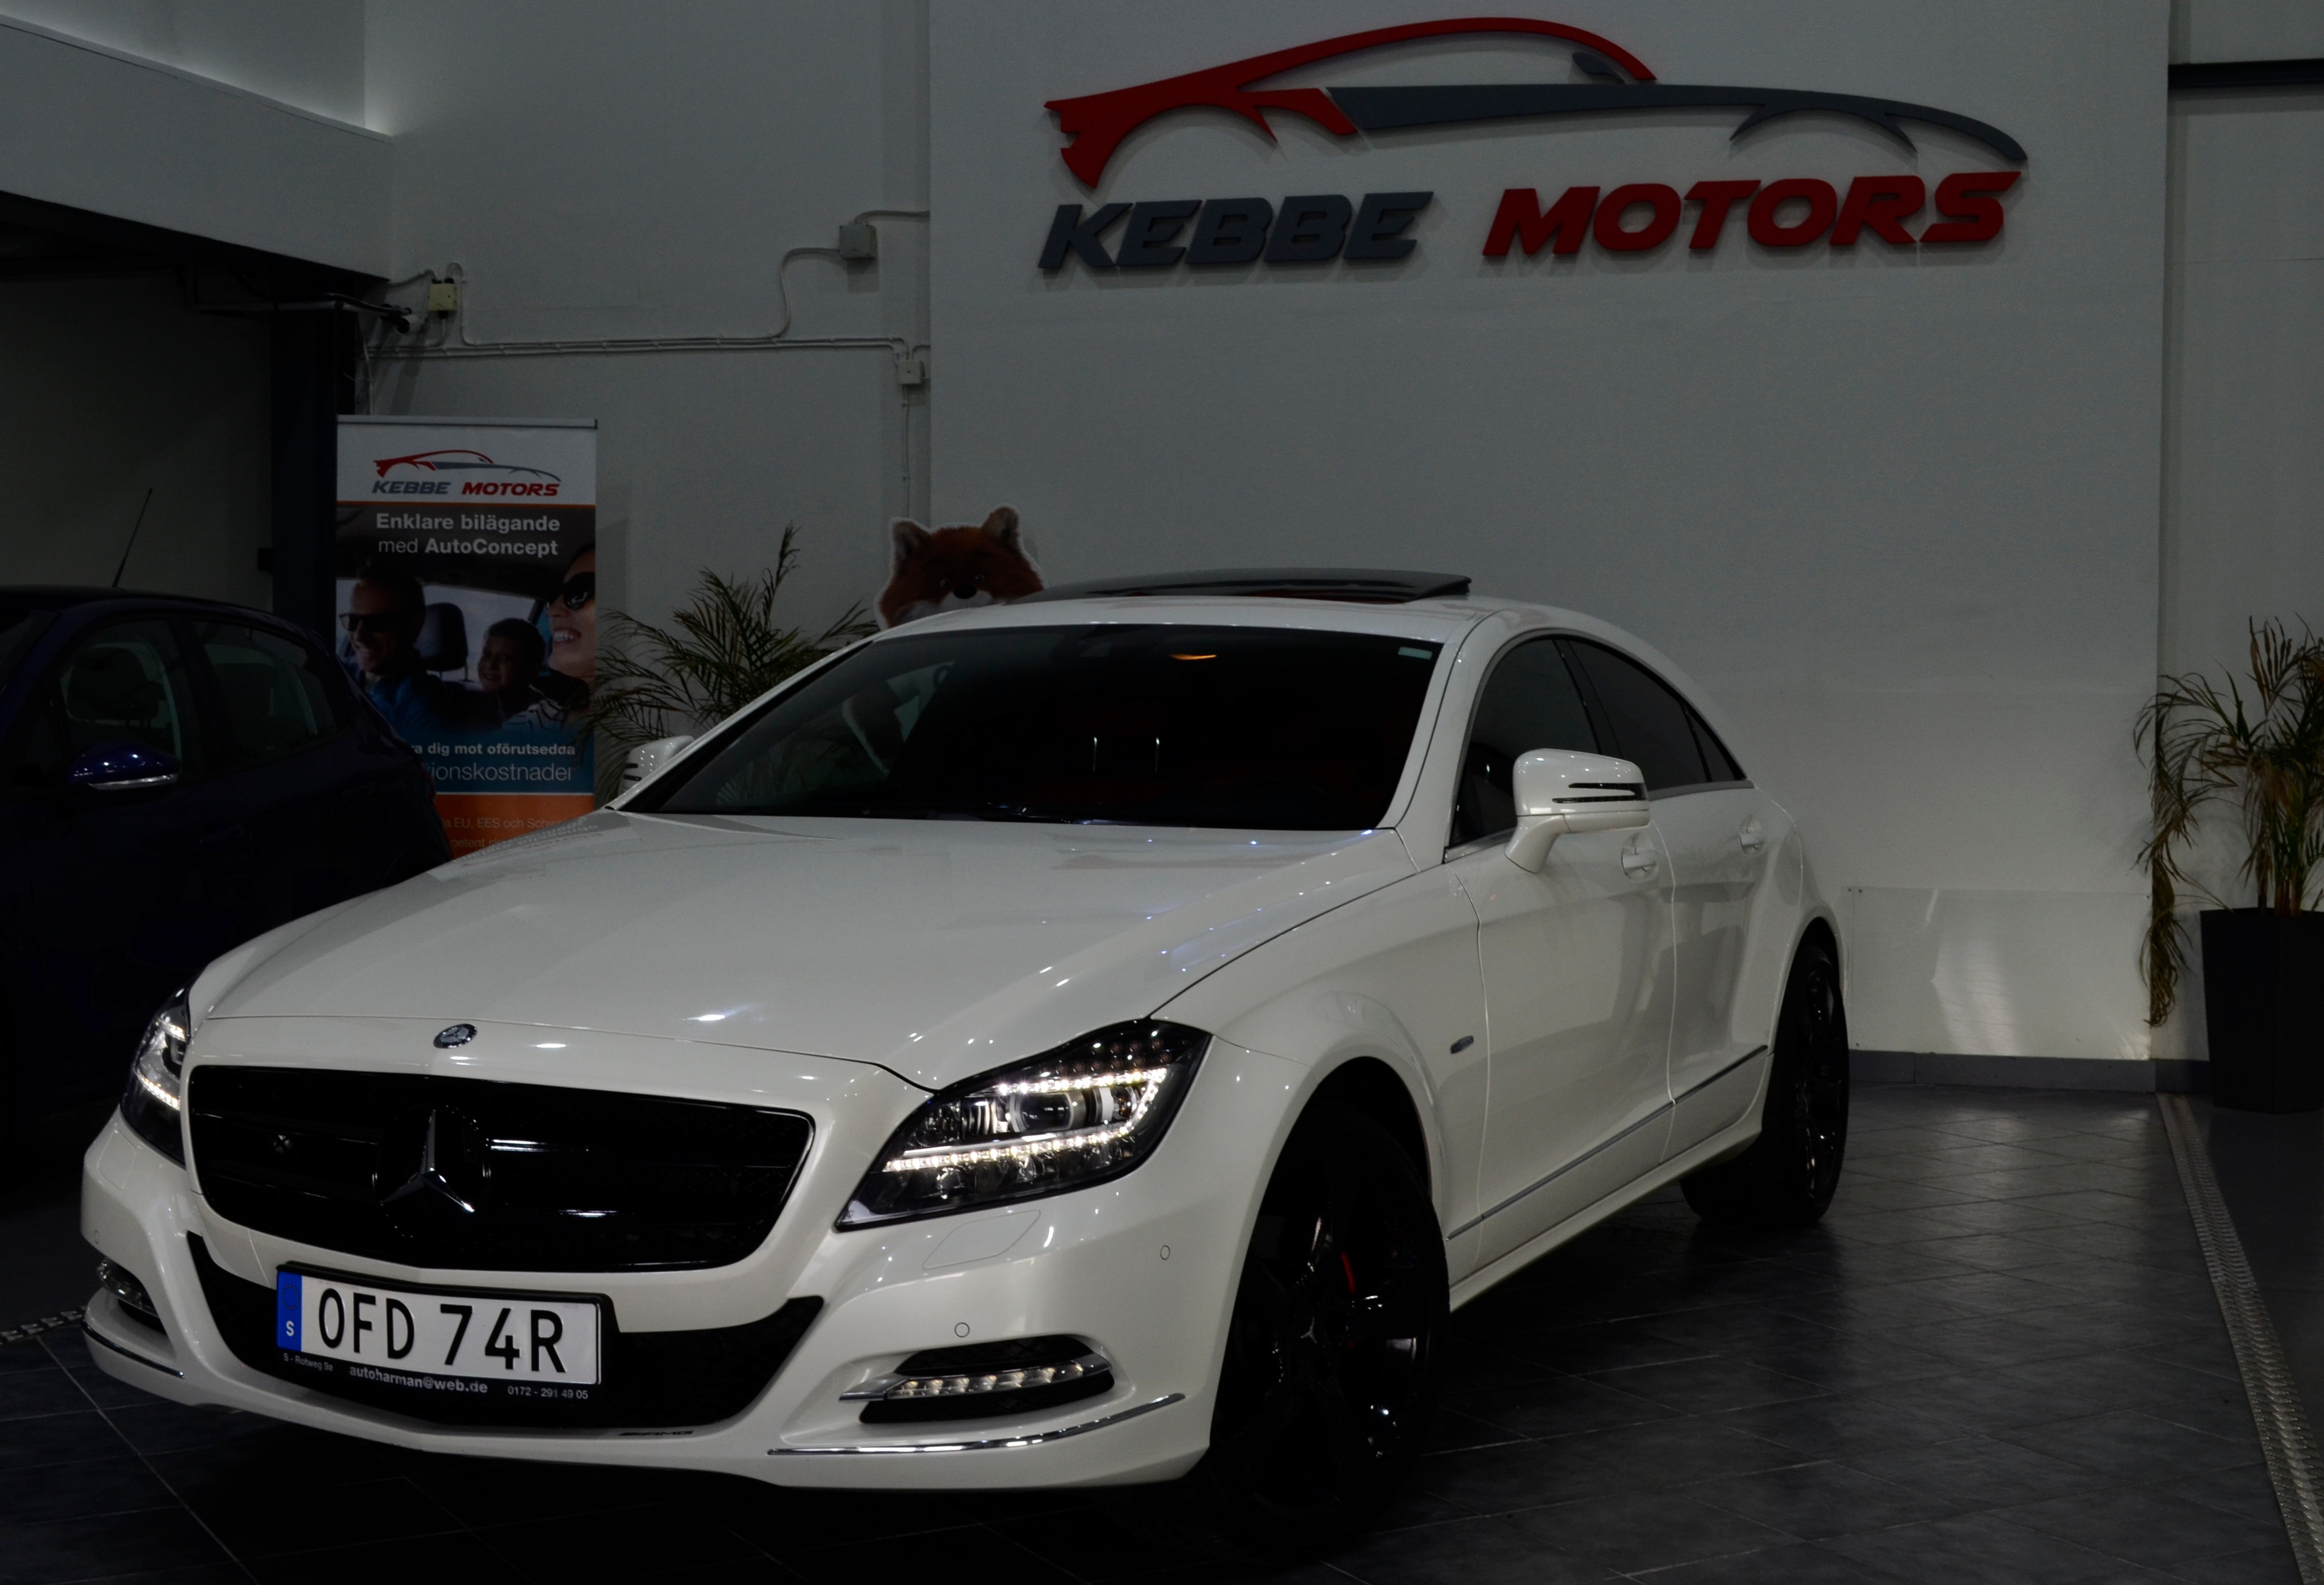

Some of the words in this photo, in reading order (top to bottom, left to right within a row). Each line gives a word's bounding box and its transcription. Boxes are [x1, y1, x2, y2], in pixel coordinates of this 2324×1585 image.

[1038, 191, 1434, 268] KEBBE
[1482, 171, 2021, 256] MOTORS
[372, 481, 451, 495] KEBBE
[462, 482, 560, 496] MOTORS
[376, 513, 454, 530] Enklare
[461, 514, 561, 534] bilägande
[378, 538, 418, 553] med
[424, 537, 559, 558] AutoConcept
[427, 742, 450, 757] dig
[454, 743, 483, 755] mot
[429, 762, 572, 781] ionskostnader
[454, 818, 473, 829] EU,
[477, 818, 500, 828] EES
[503, 818, 524, 828] och
[285, 1320, 295, 1337] S
[319, 1288, 414, 1359] OFD
[440, 1303, 566, 1373] 74R
[283, 1352, 289, 1362] S
[323, 1361, 334, 1371] 9a
[349, 1366, 489, 1393] autoharman@web.de
[507, 1386, 531, 1396] 0172
[540, 1387, 558, 1398] 291
[561, 1389, 574, 1399] 49
[576, 1390, 589, 1399] 05
